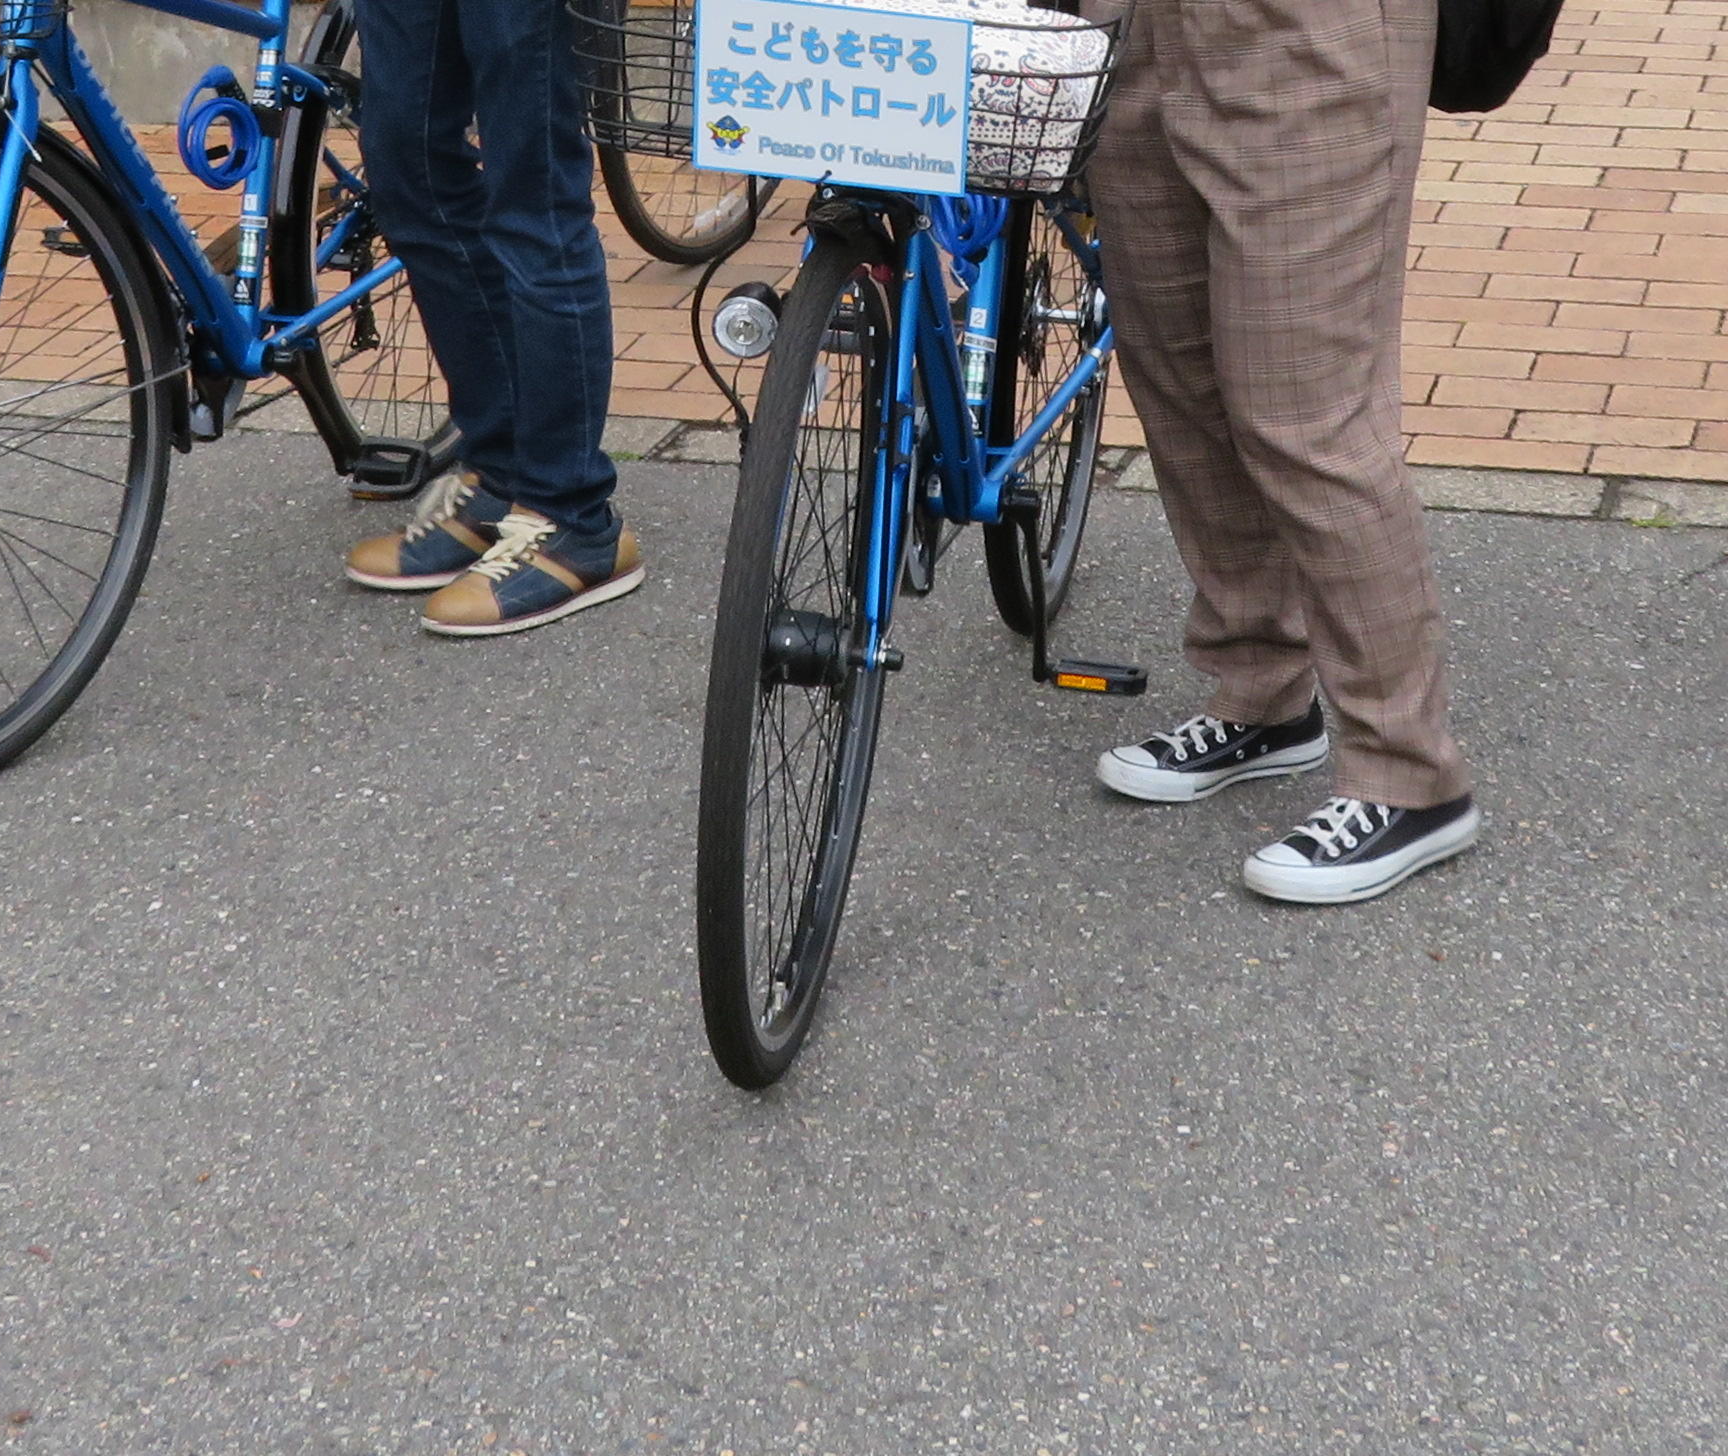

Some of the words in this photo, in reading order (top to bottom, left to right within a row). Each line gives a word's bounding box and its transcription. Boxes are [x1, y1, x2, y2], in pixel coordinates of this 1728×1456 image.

[727, 20, 938, 76] こどもを守る
[706, 67, 958, 128] 安全パトロール
[758, 135, 816, 160] Peace
[821, 141, 846, 163] Of
[849, 146, 956, 175] Tokushima
[973, 311, 984, 325] 2
